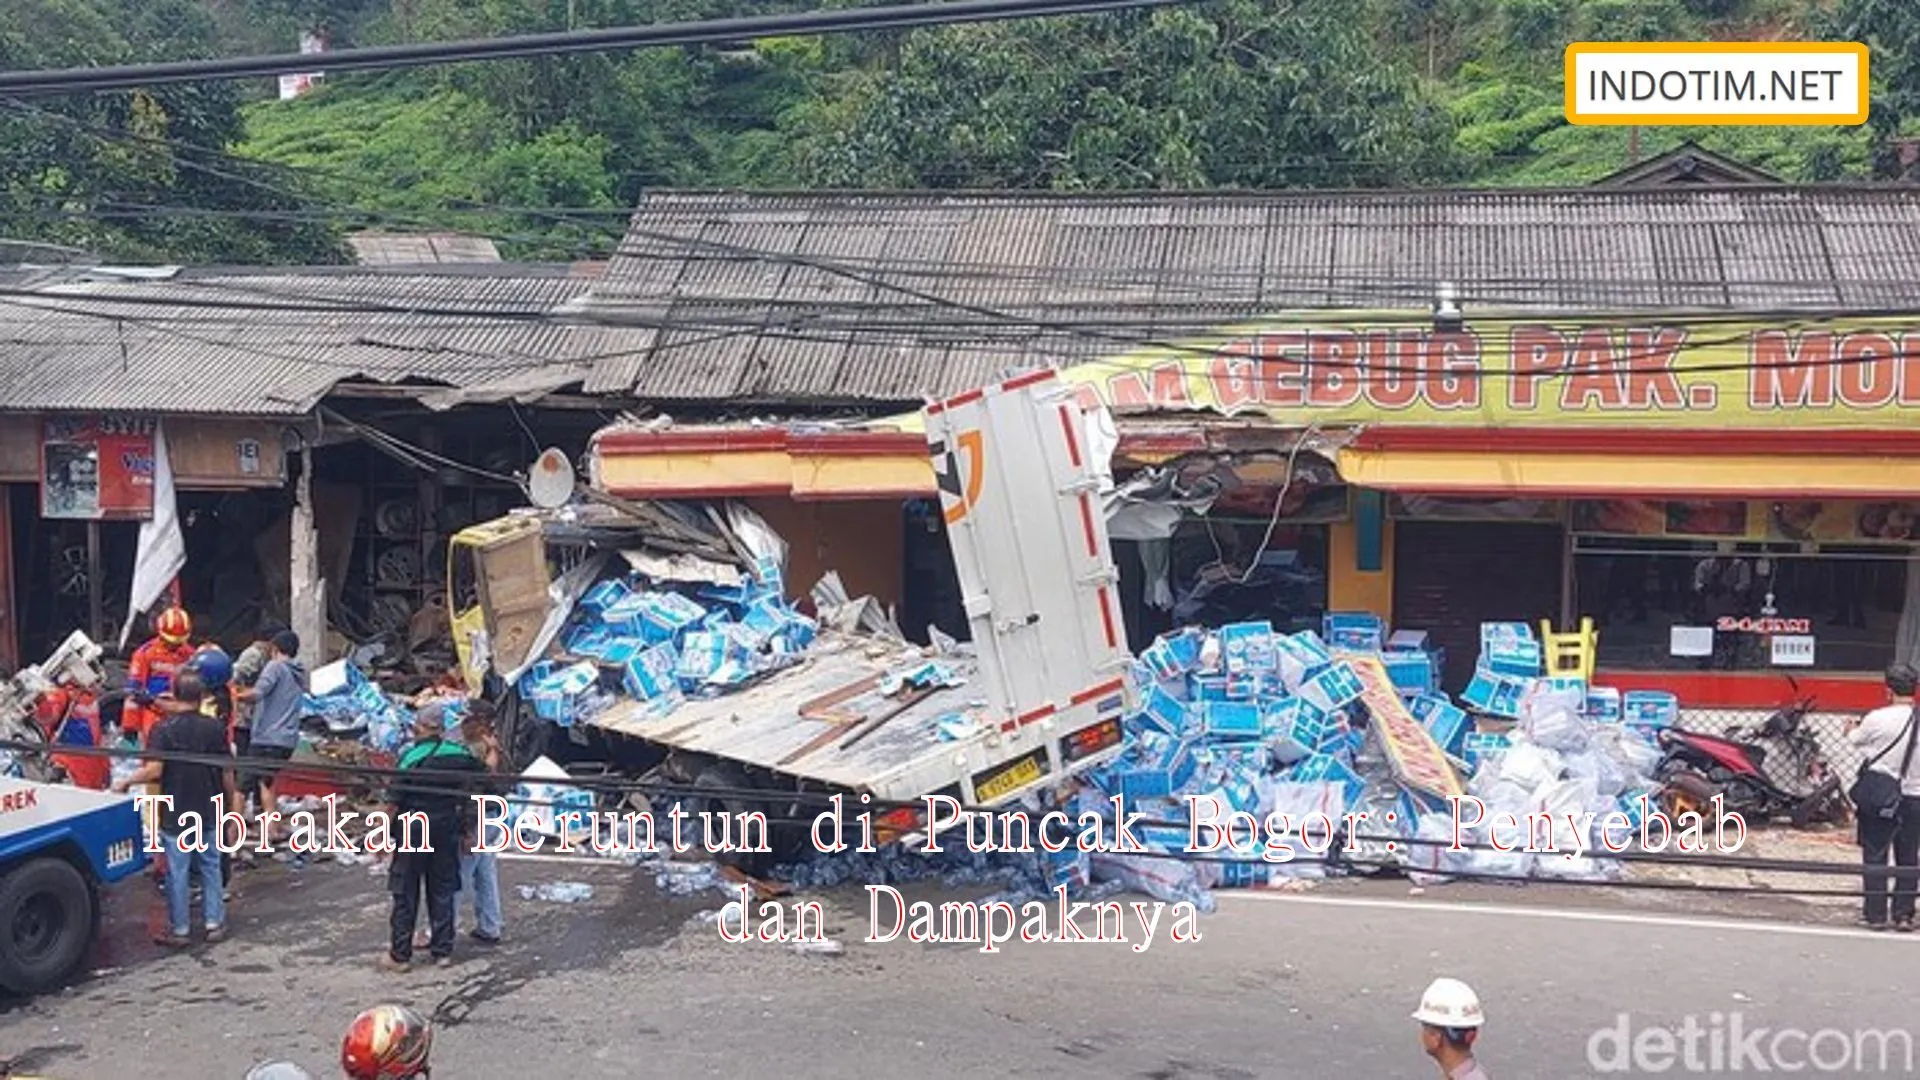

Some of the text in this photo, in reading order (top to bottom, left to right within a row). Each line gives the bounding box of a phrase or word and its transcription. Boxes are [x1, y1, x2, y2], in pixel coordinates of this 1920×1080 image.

[1209, 328, 1482, 414] GEBUG
[1507, 325, 1718, 410] PAK.
[0, 787, 38, 812] REK
